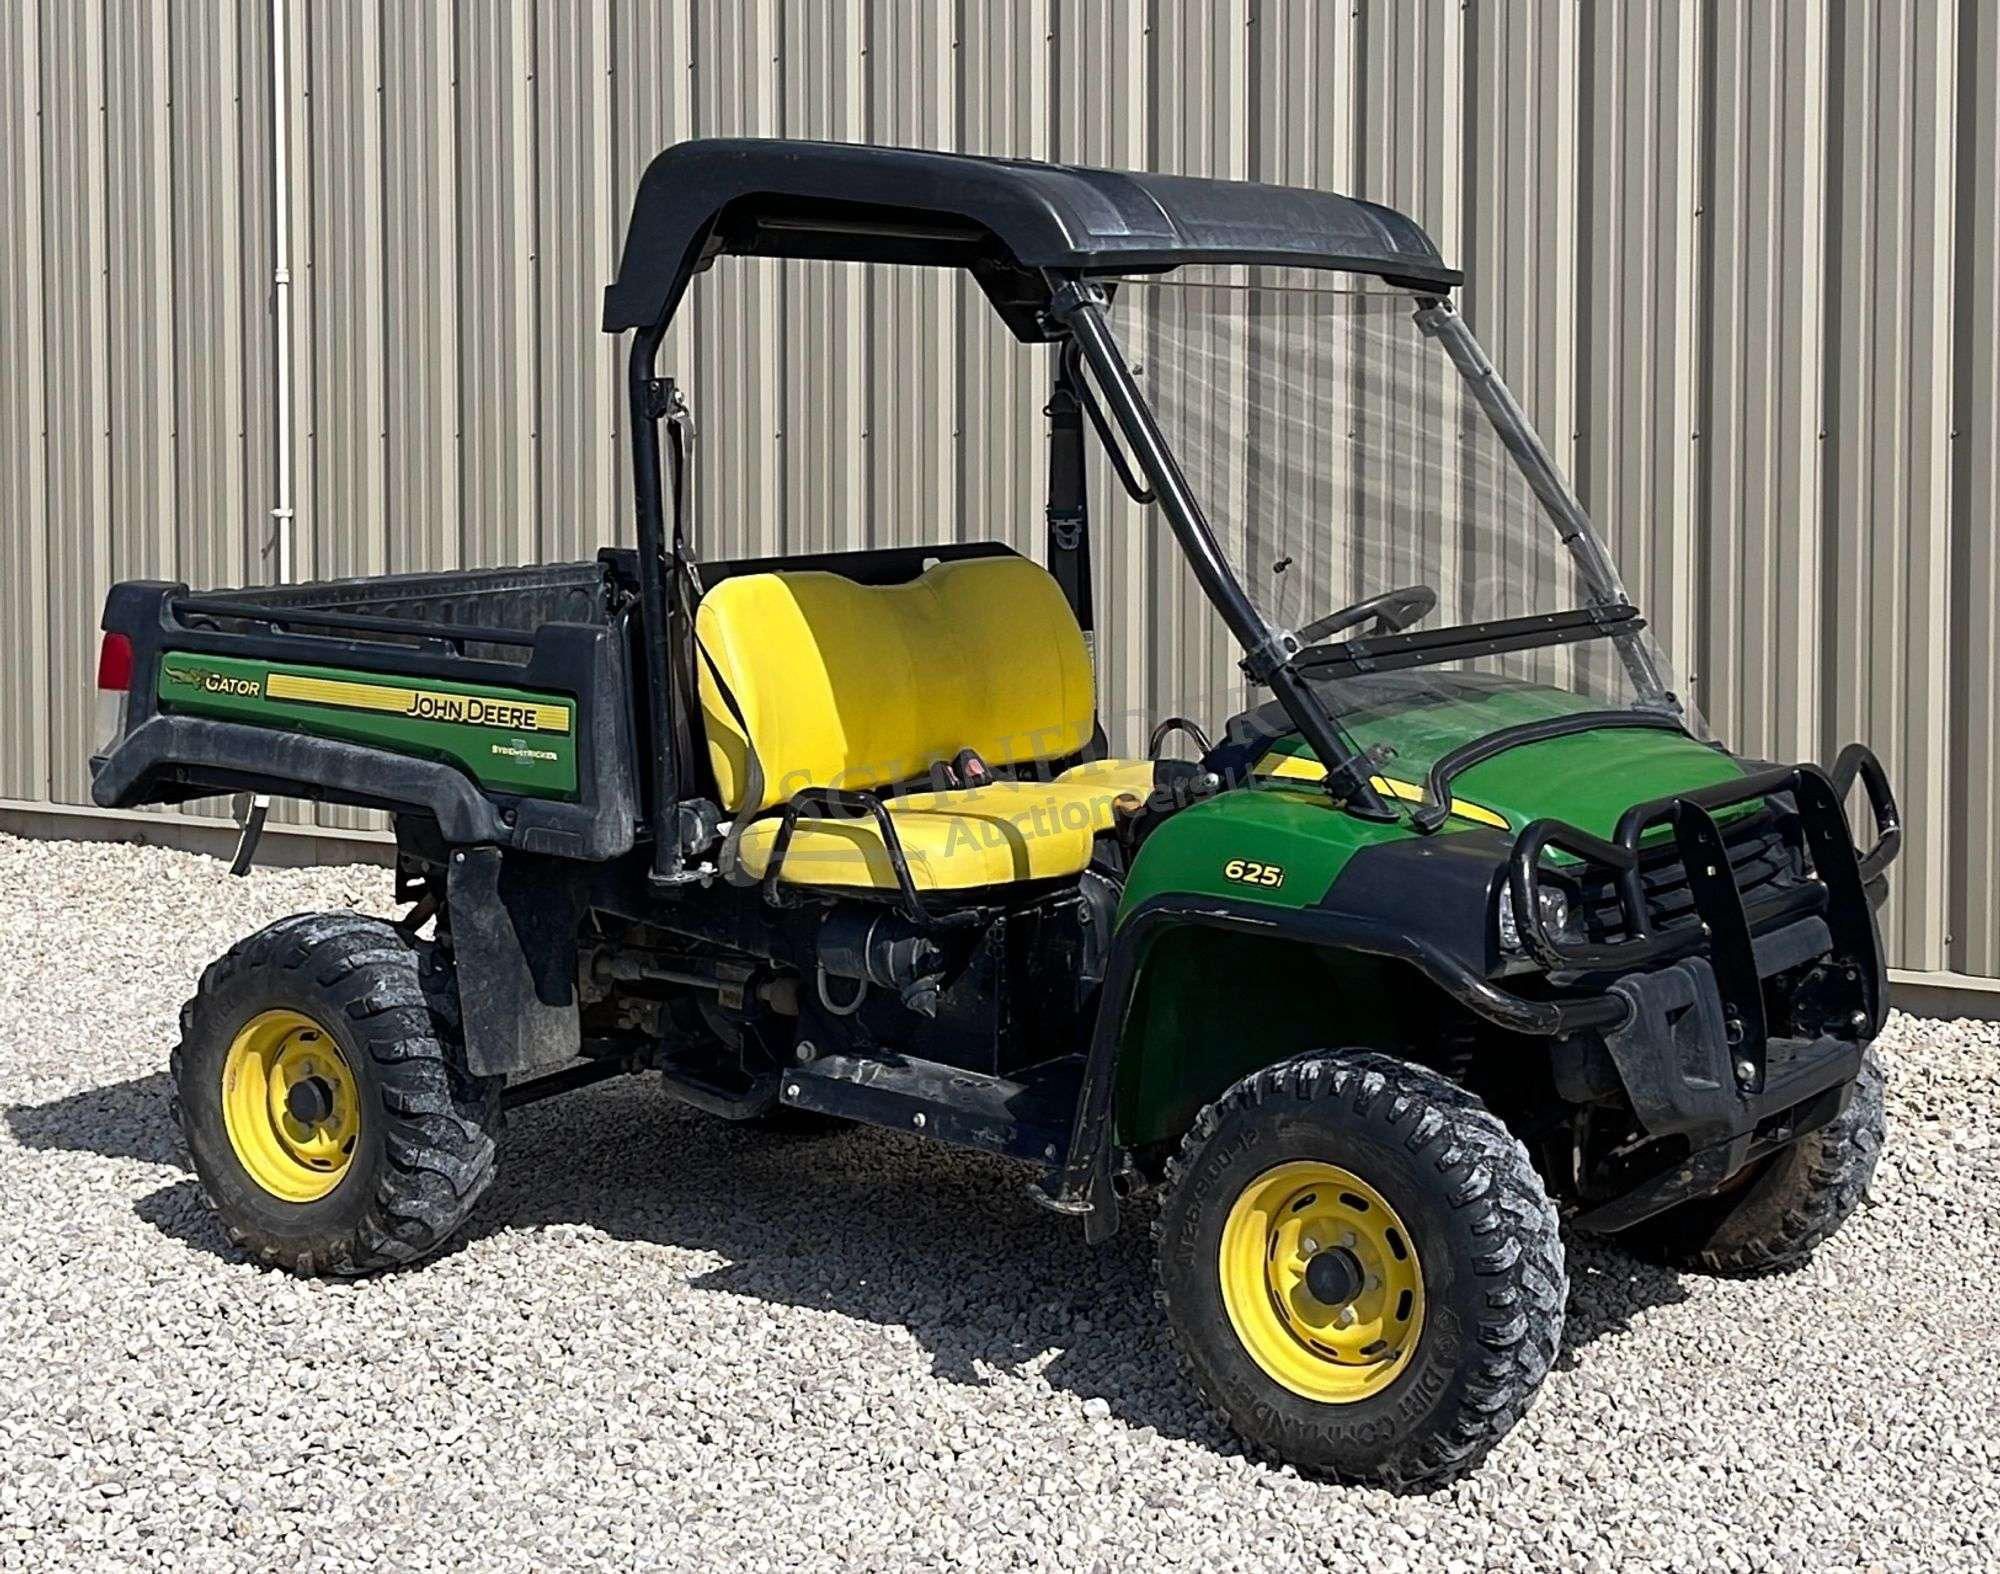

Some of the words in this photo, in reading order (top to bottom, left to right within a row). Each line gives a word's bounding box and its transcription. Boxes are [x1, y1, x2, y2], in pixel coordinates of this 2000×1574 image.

[205, 674, 260, 697] GATOR
[406, 693, 465, 721] JOHN
[467, 698, 539, 729] DEERE
[1223, 858, 1284, 887] 625i
[1400, 1362, 1444, 1419] DIRT
